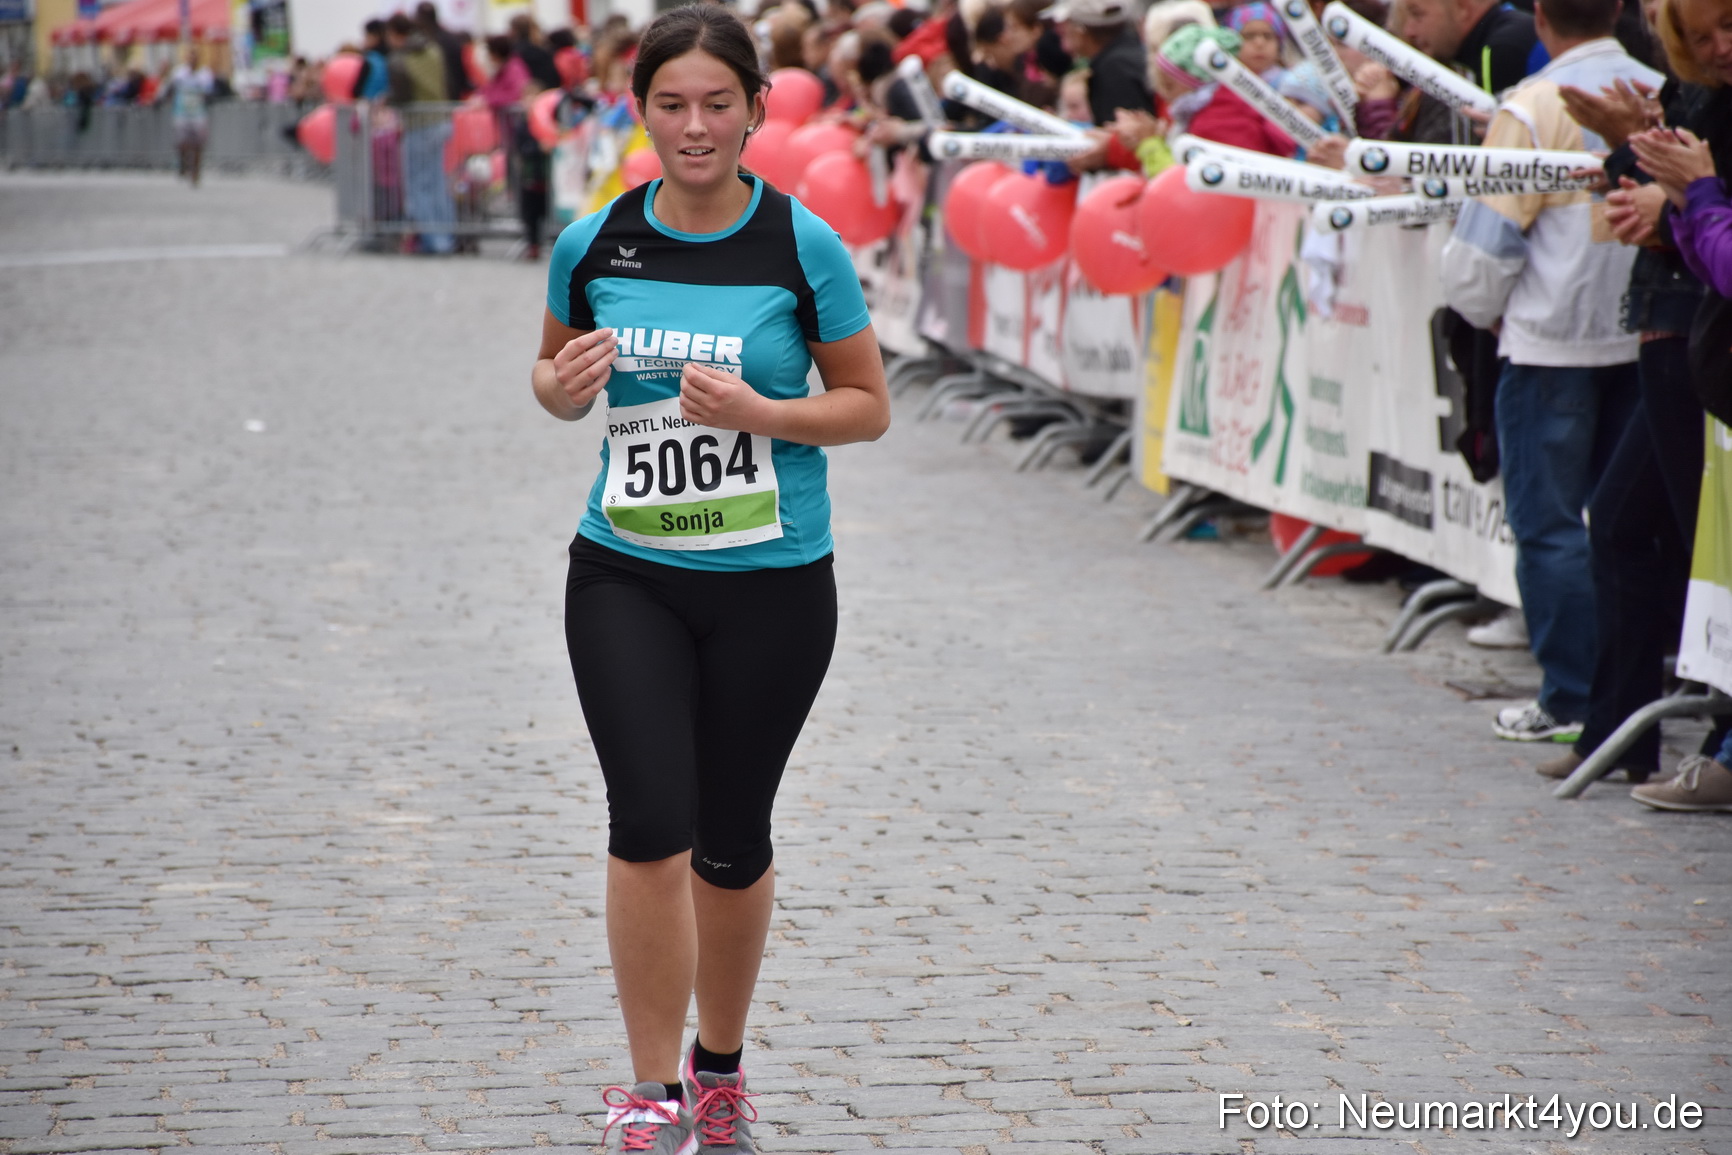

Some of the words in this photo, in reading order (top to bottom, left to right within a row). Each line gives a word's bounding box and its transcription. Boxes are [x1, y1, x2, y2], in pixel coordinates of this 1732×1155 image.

[1408, 151, 1477, 178] BMW
[1238, 171, 1294, 194] BMW
[610, 258, 642, 269] erima
[611, 327, 743, 365] HUBER
[636, 372, 669, 382] WASTE
[608, 418, 660, 438] PARTL
[624, 431, 759, 499] 5064
[659, 508, 724, 534] Sonja
